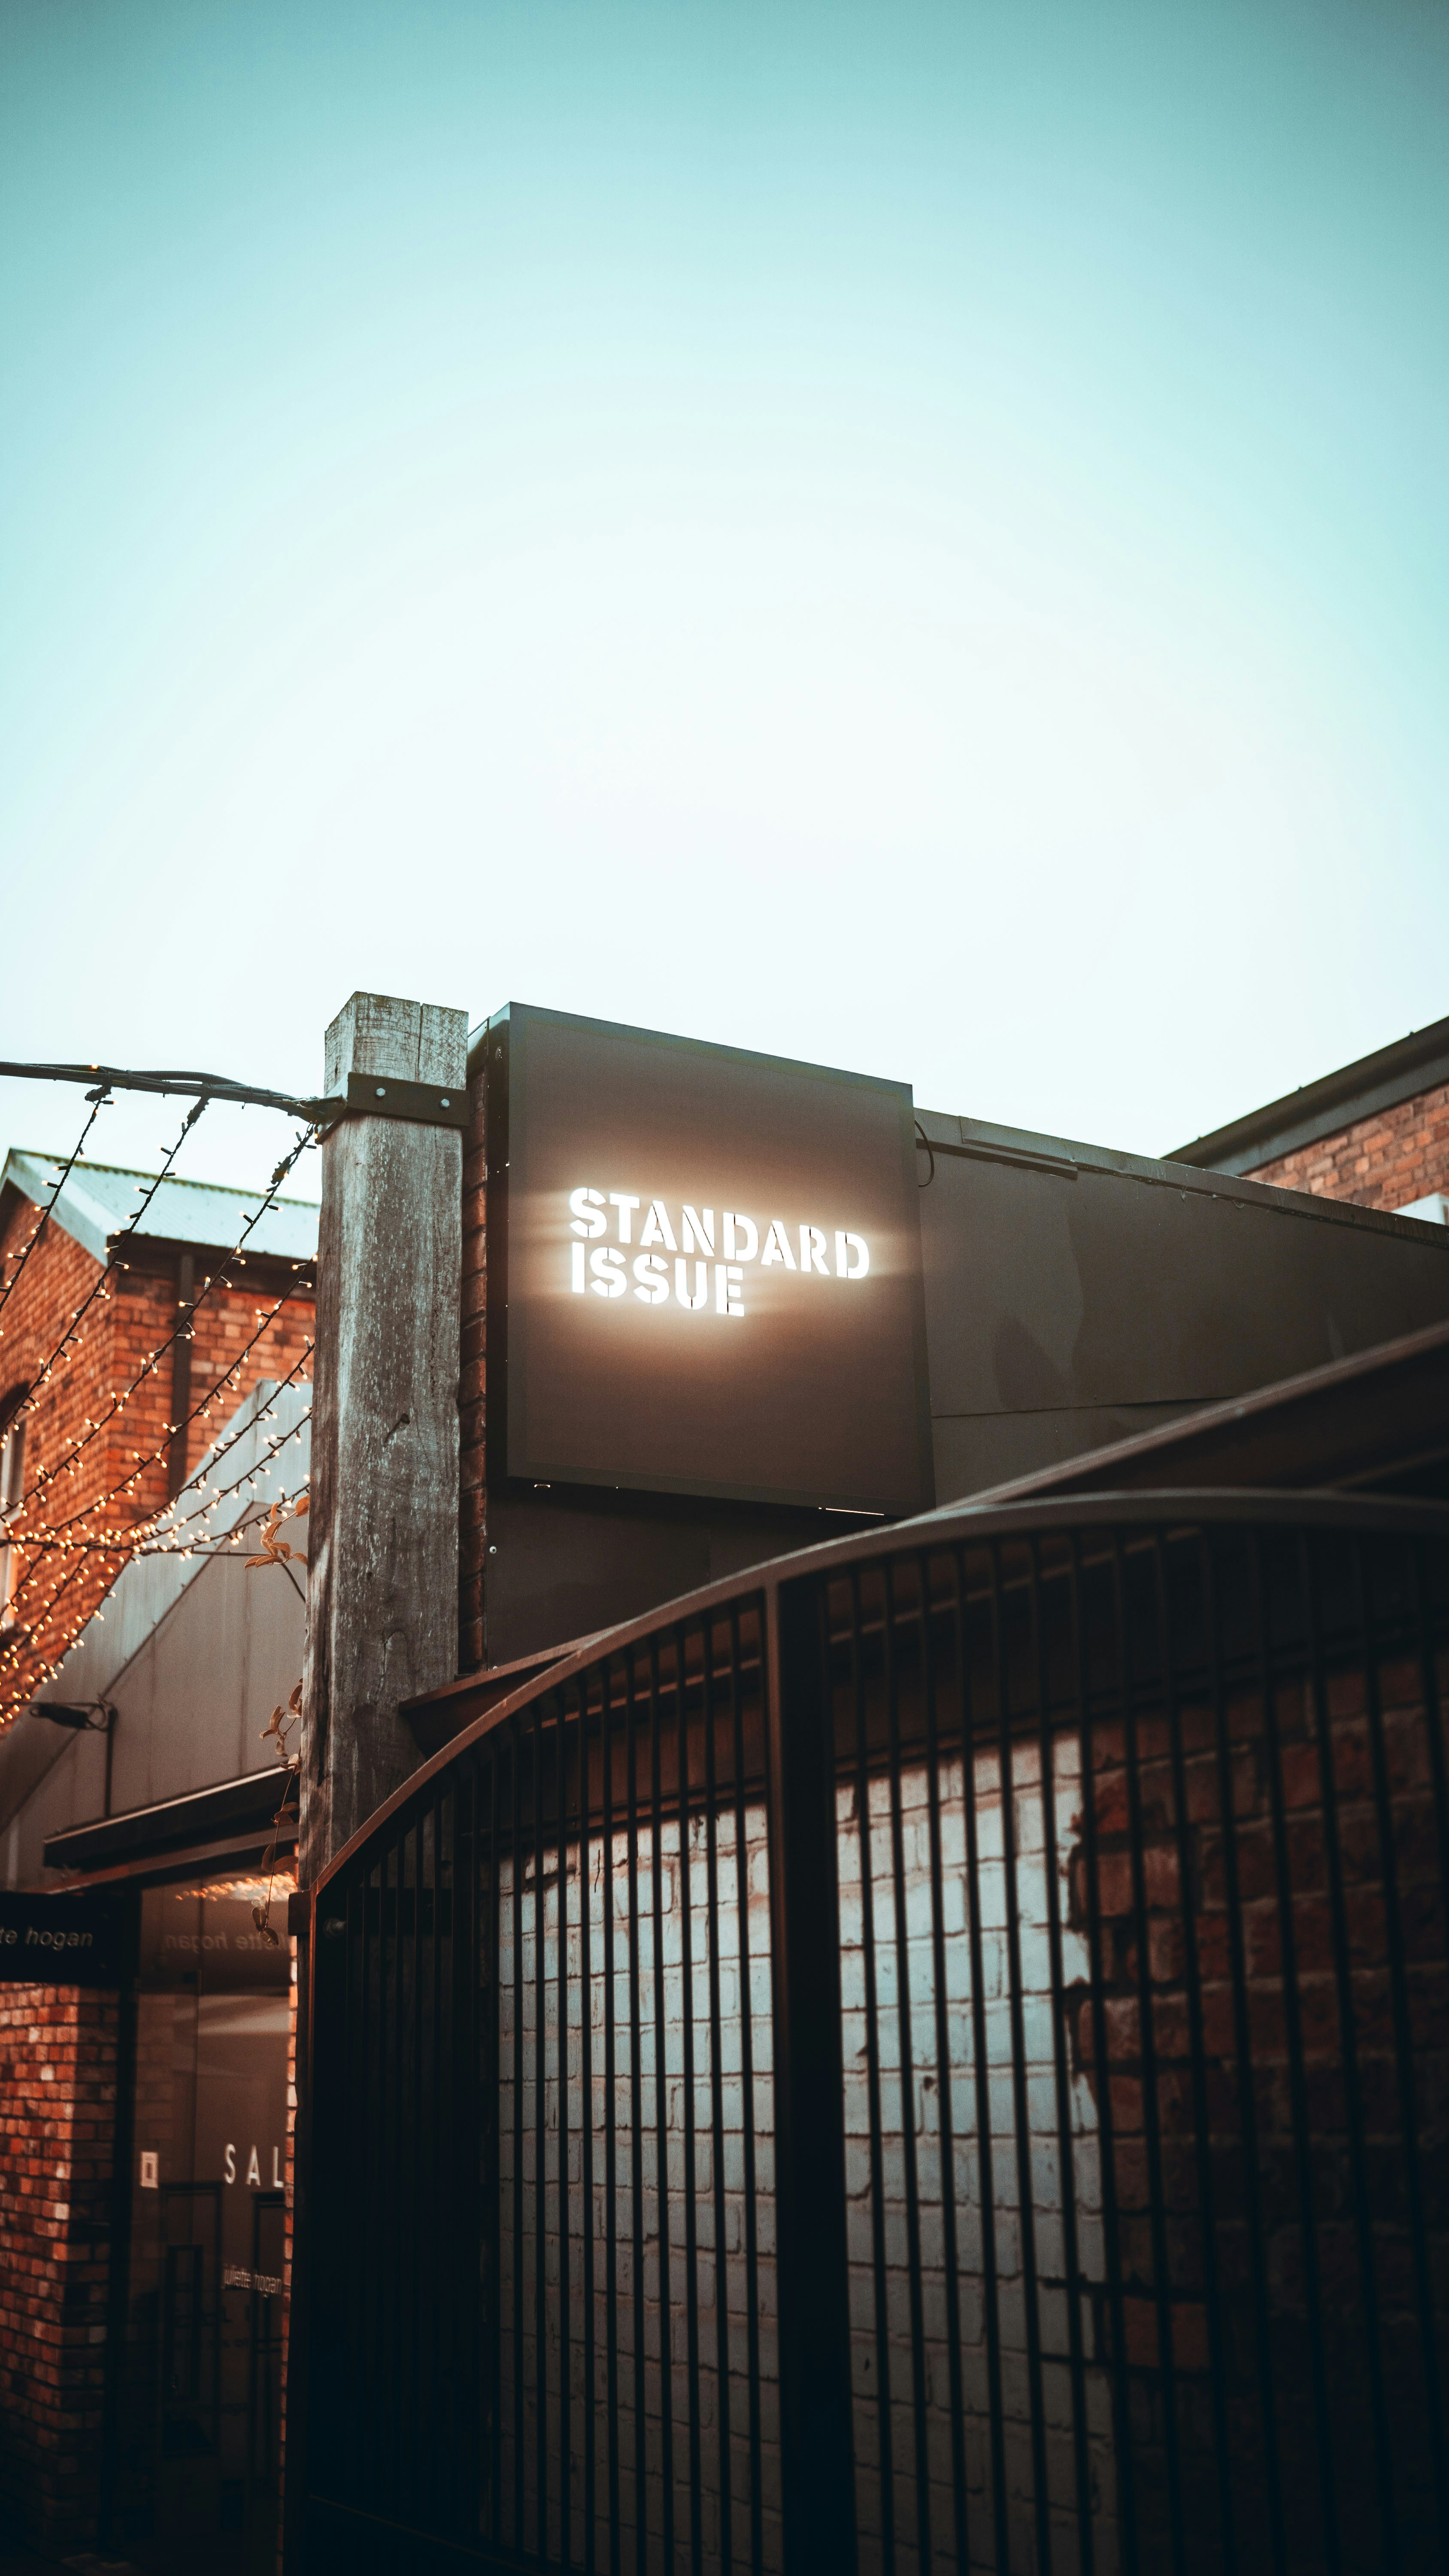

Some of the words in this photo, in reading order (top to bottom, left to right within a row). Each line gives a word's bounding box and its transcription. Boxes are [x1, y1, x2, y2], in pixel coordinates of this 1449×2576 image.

[569, 1187, 870, 1279] STANDARD
[572, 1242, 745, 1317] ISSUE
[25, 1925, 93, 1951] hogan
[224, 2143, 284, 2188] SAL
[253, 2269, 282, 2298] hogan
